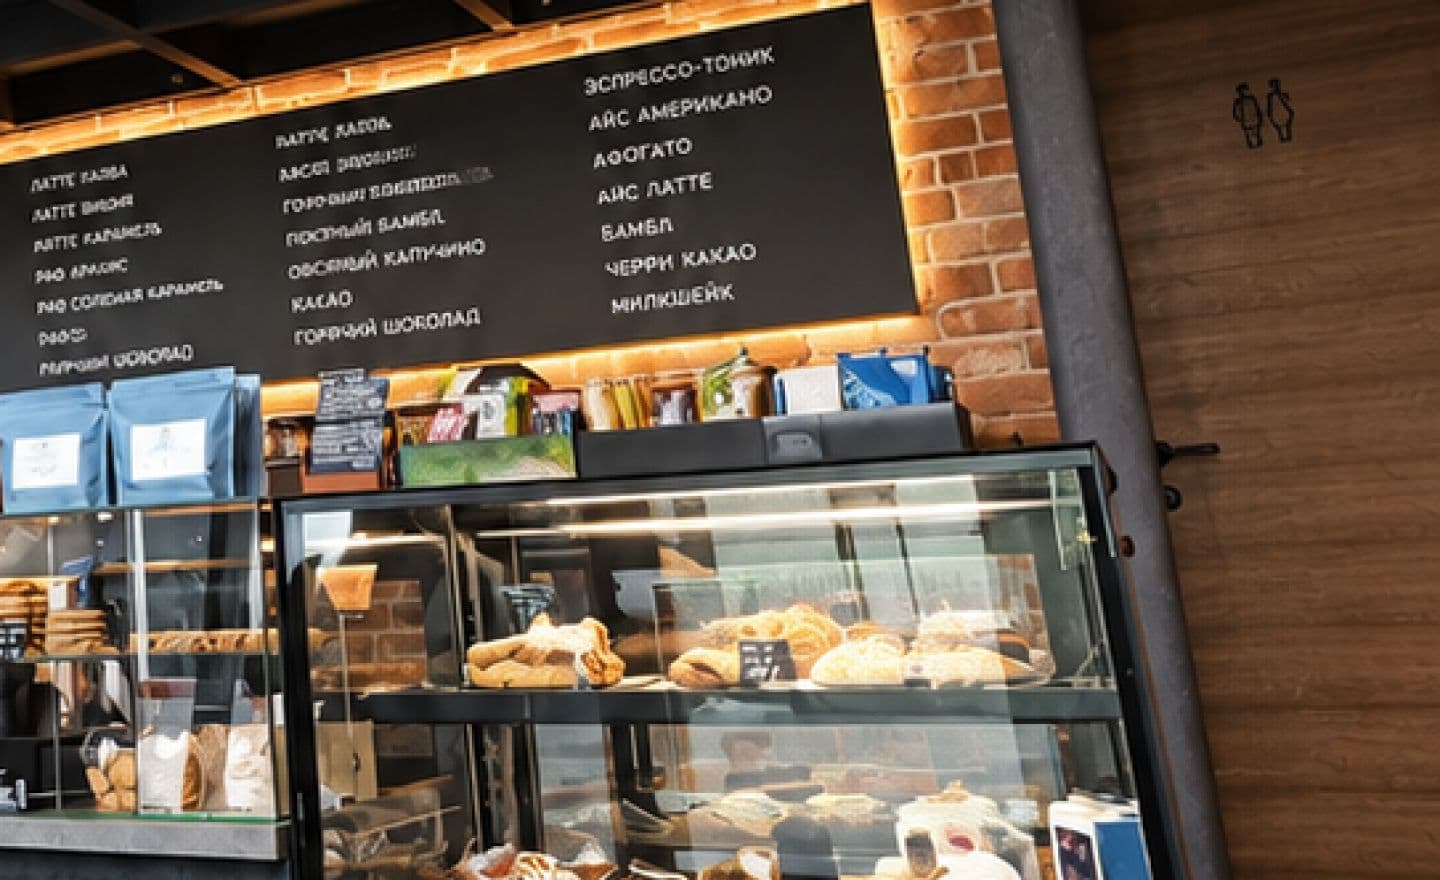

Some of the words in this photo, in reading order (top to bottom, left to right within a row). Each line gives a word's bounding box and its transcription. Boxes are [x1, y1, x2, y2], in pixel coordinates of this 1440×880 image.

[584, 46, 775, 96] ЭСПРЕССО-ТОНИК
[589, 109, 631, 131] АЙС
[637, 85, 772, 122] АМЕРИКАНО
[647, 172, 713, 197] ЛАТТЕ
[602, 217, 674, 242] БАМБЛ
[605, 254, 674, 276] ЧЕРРИ
[681, 244, 756, 268] КАКАО
[612, 281, 735, 313] МИЛКШЕЙК
